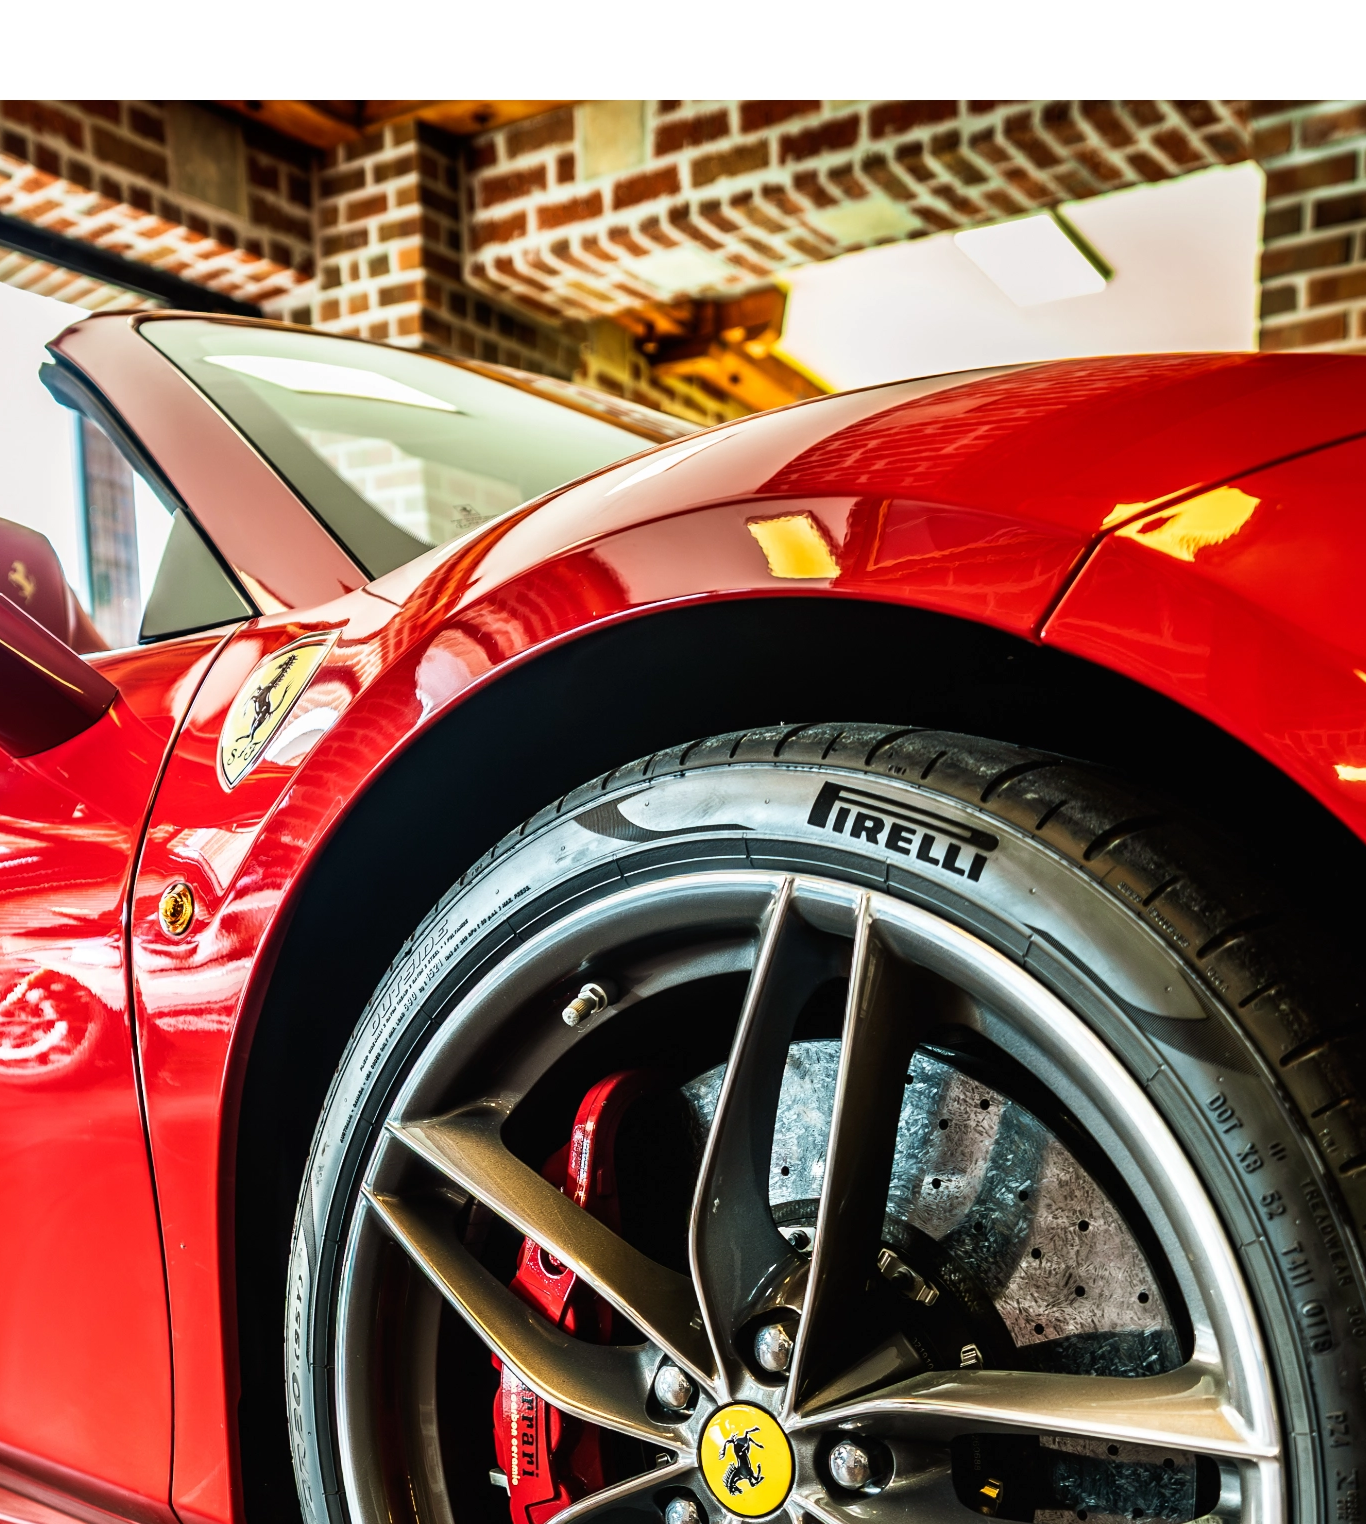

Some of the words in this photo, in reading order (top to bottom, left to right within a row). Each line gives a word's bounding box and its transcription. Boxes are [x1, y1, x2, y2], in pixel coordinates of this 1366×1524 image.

[807, 781, 999, 882] PIRELLI
[371, 918, 449, 1036] OUTSIDE
[1207, 1091, 1243, 1137] DOT
[1259, 1189, 1286, 1221] 52
[1300, 1177, 1354, 1288] TREADWEAR
[520, 1382, 539, 1478] rrari
